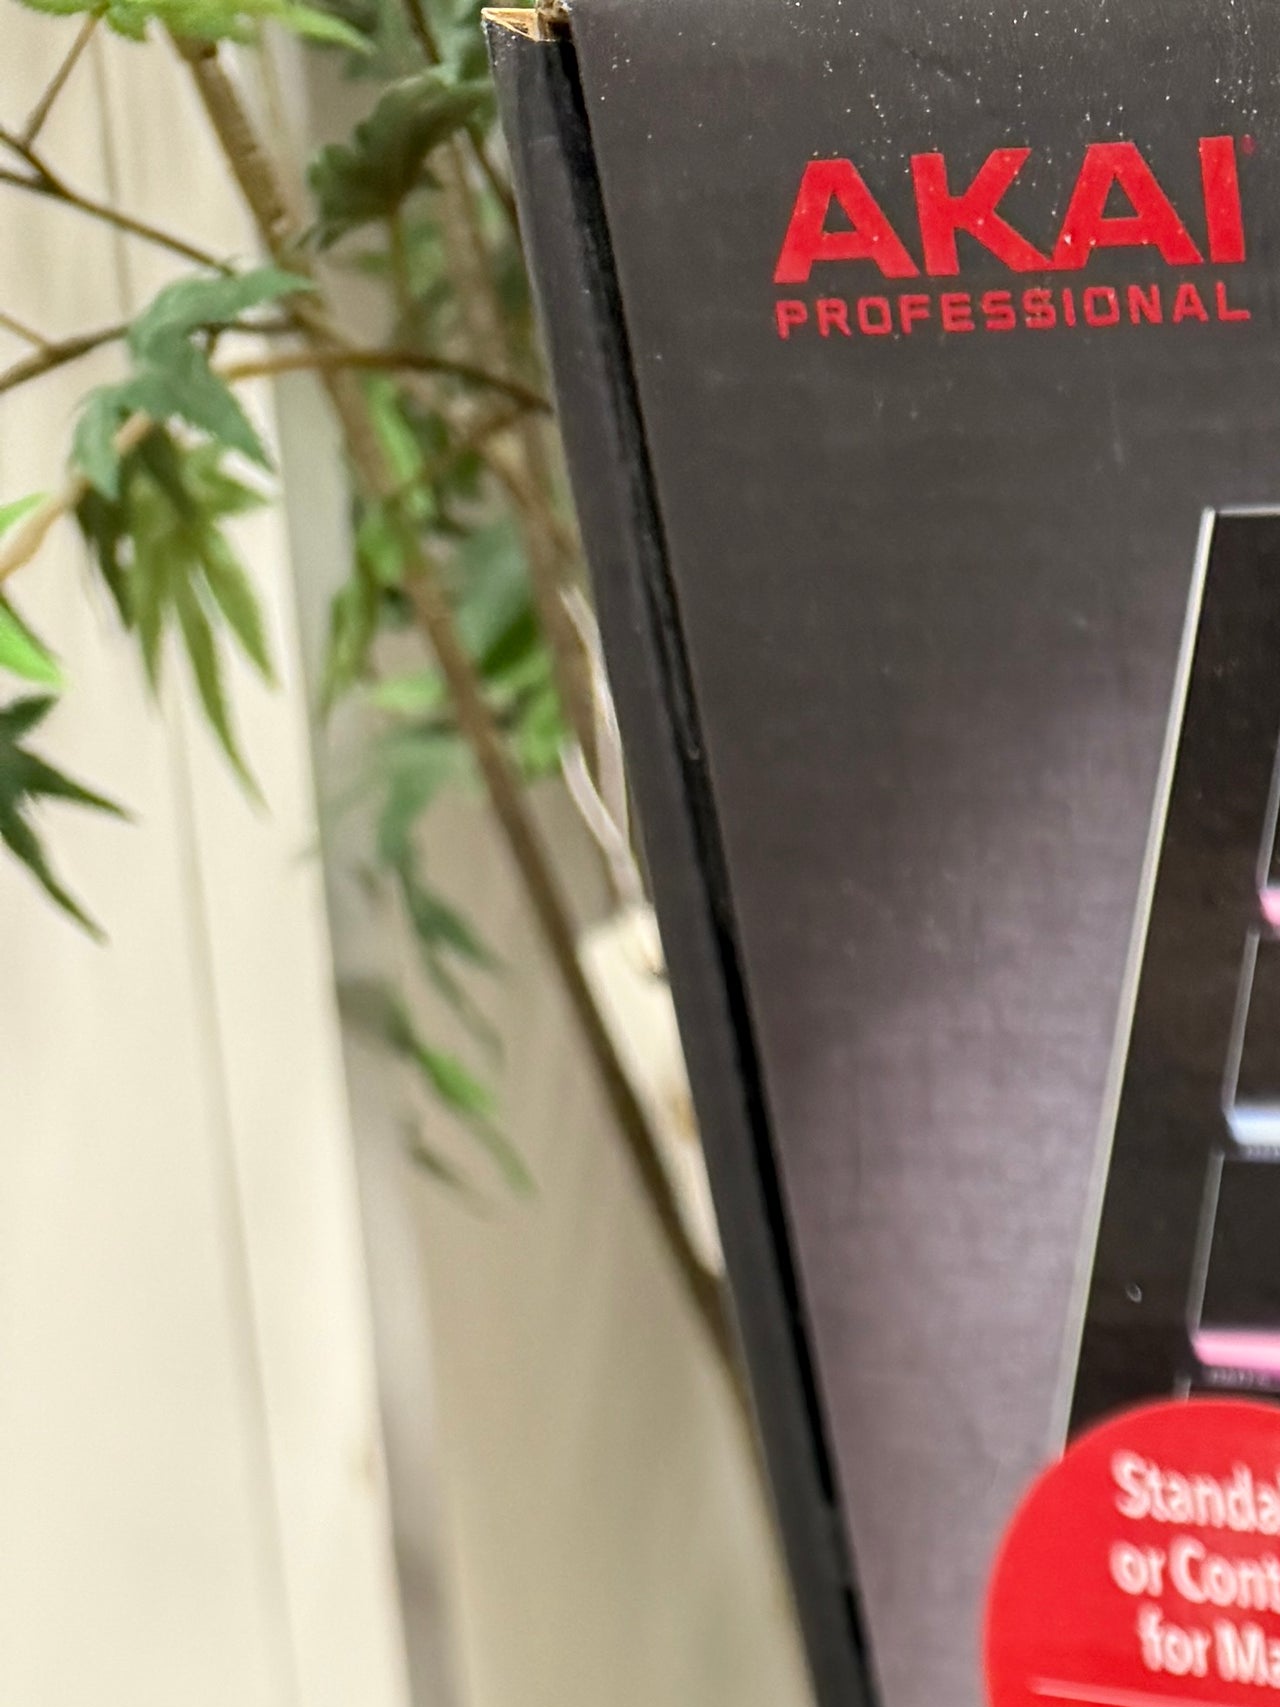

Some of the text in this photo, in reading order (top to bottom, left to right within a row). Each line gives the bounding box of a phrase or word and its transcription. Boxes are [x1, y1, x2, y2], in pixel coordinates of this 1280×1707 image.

[774, 136, 1246, 284] AKAI
[776, 282, 1251, 340] PROFESSIONAL
[1109, 1542, 1165, 1597] or
[1137, 1604, 1212, 1679] for
